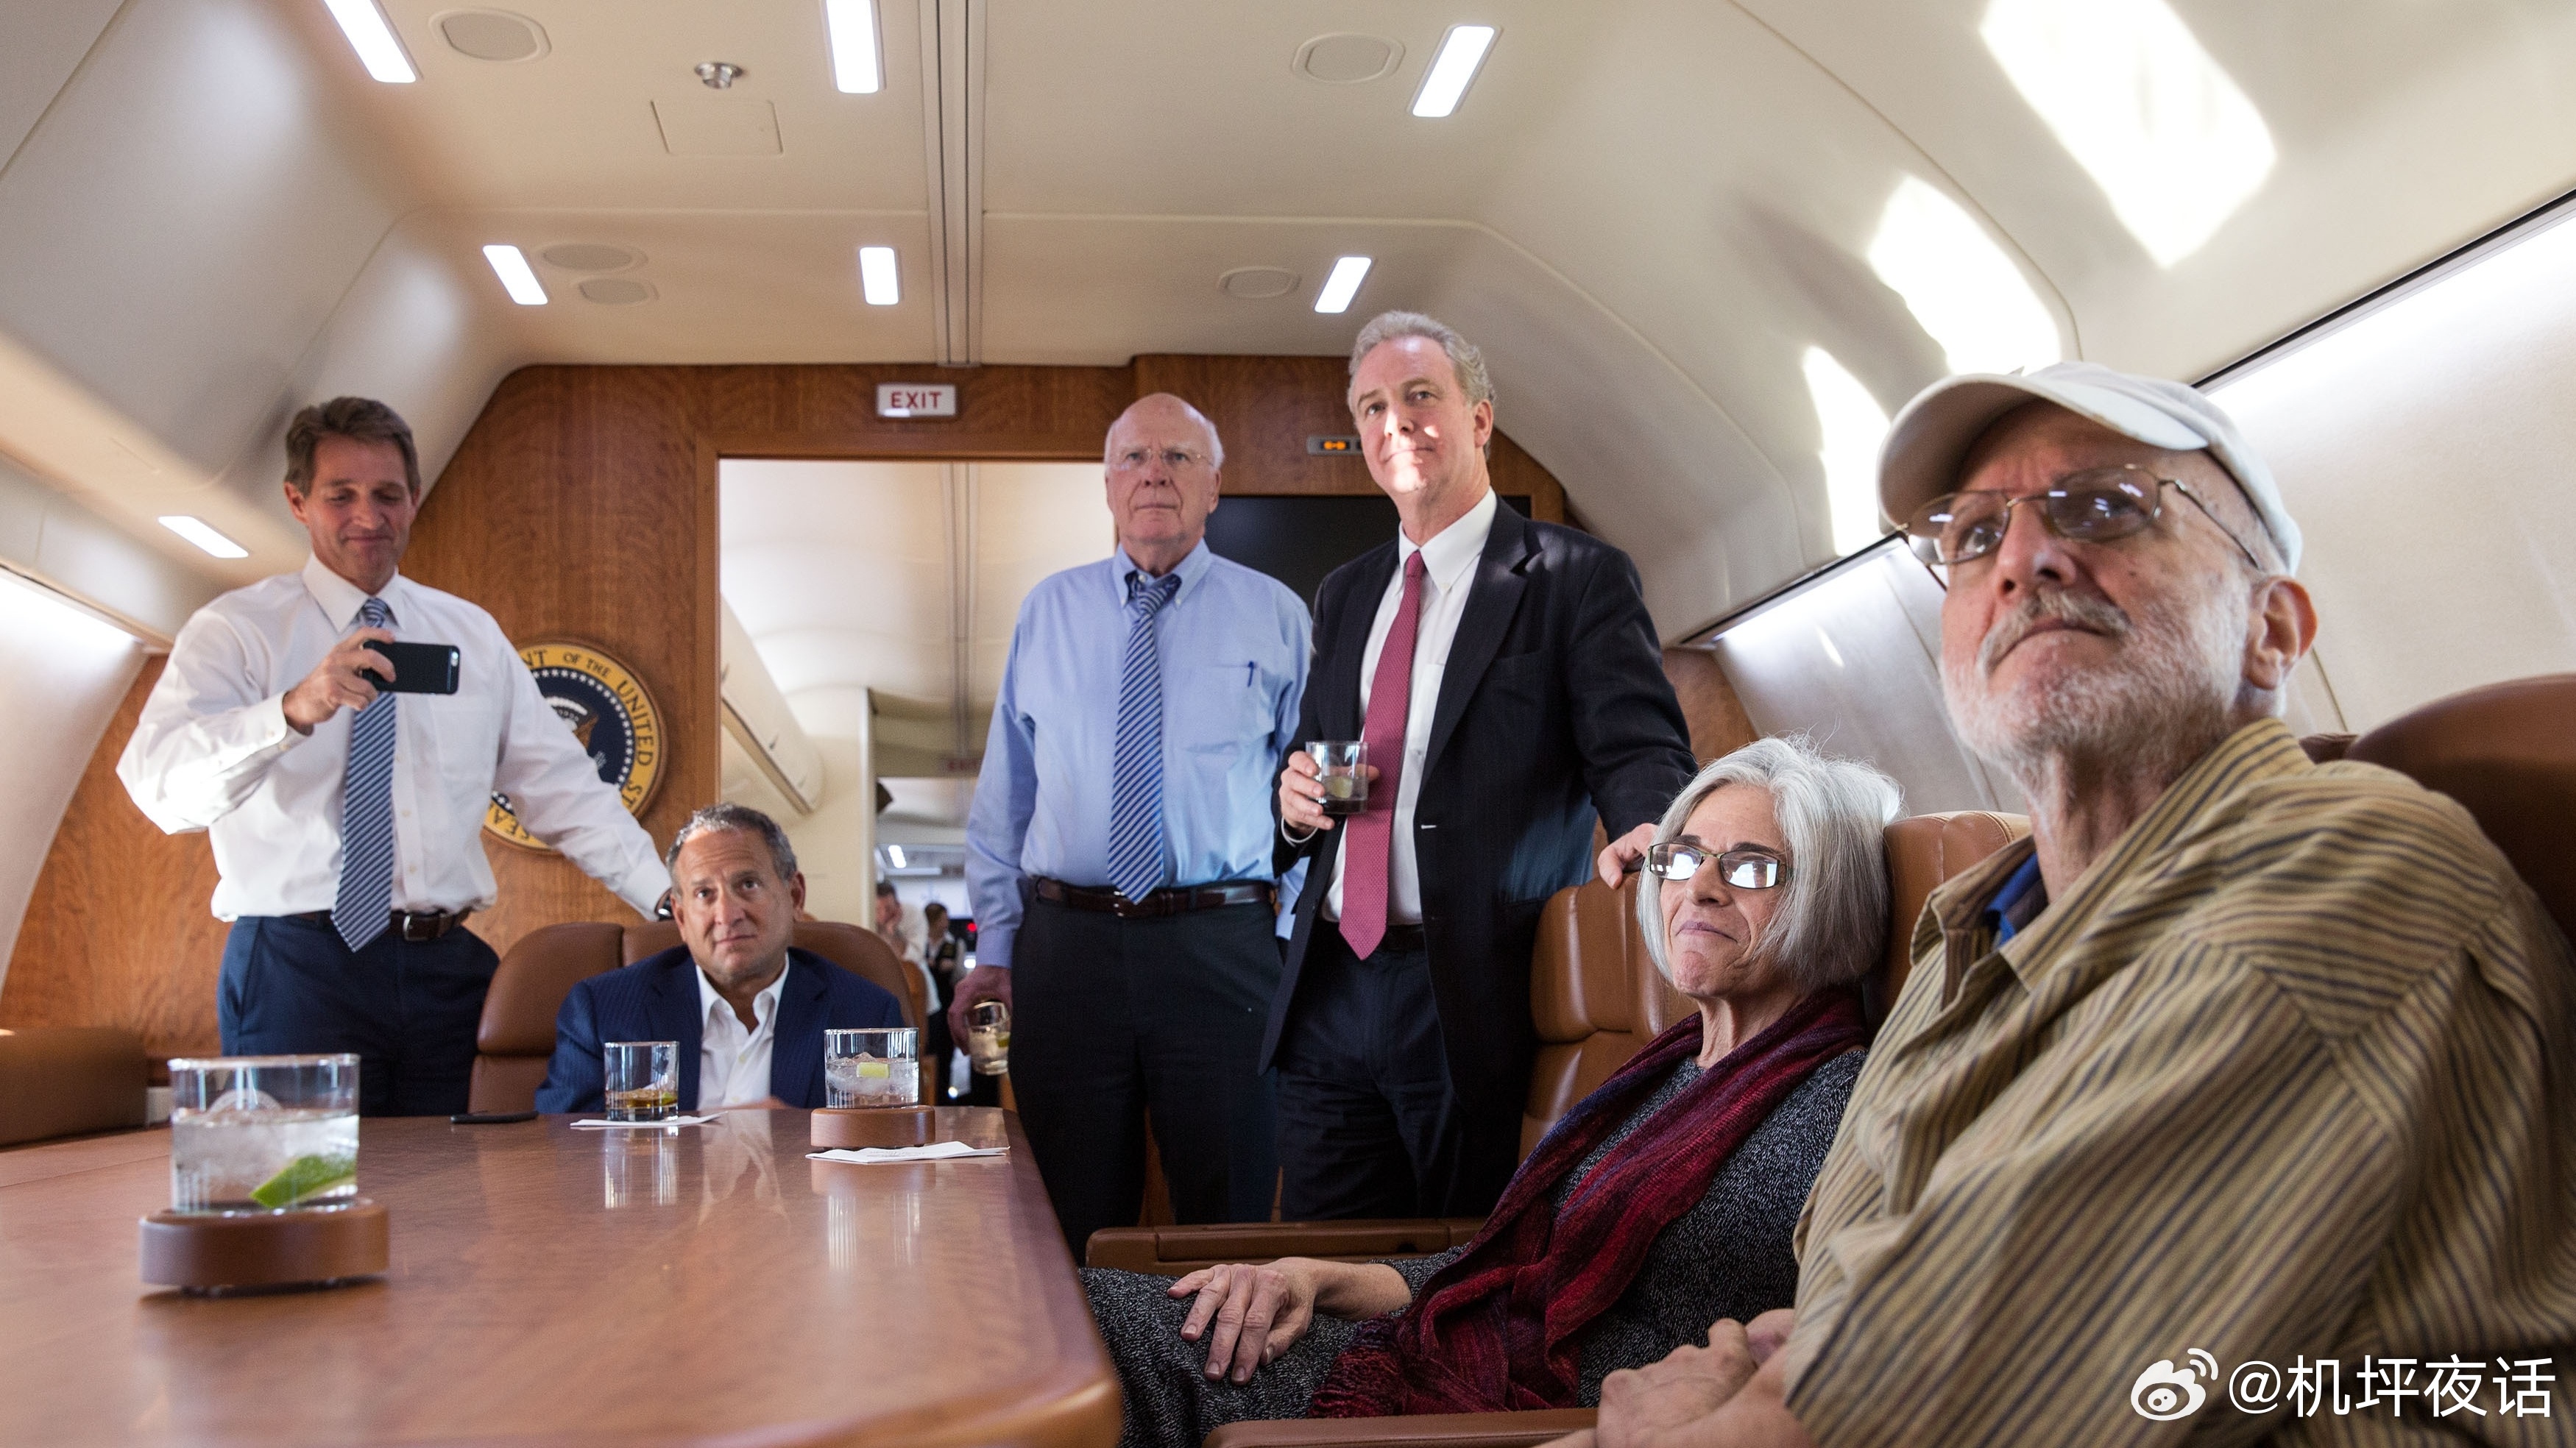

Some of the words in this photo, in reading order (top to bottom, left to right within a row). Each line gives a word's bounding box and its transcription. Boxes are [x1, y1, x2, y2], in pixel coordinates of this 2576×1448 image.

[891, 391, 941, 408] EXIT
[522, 649, 548, 667] NT
[587, 659, 611, 677] THE
[617, 680, 654, 766] UNITED
[622, 780, 643, 809] ST
